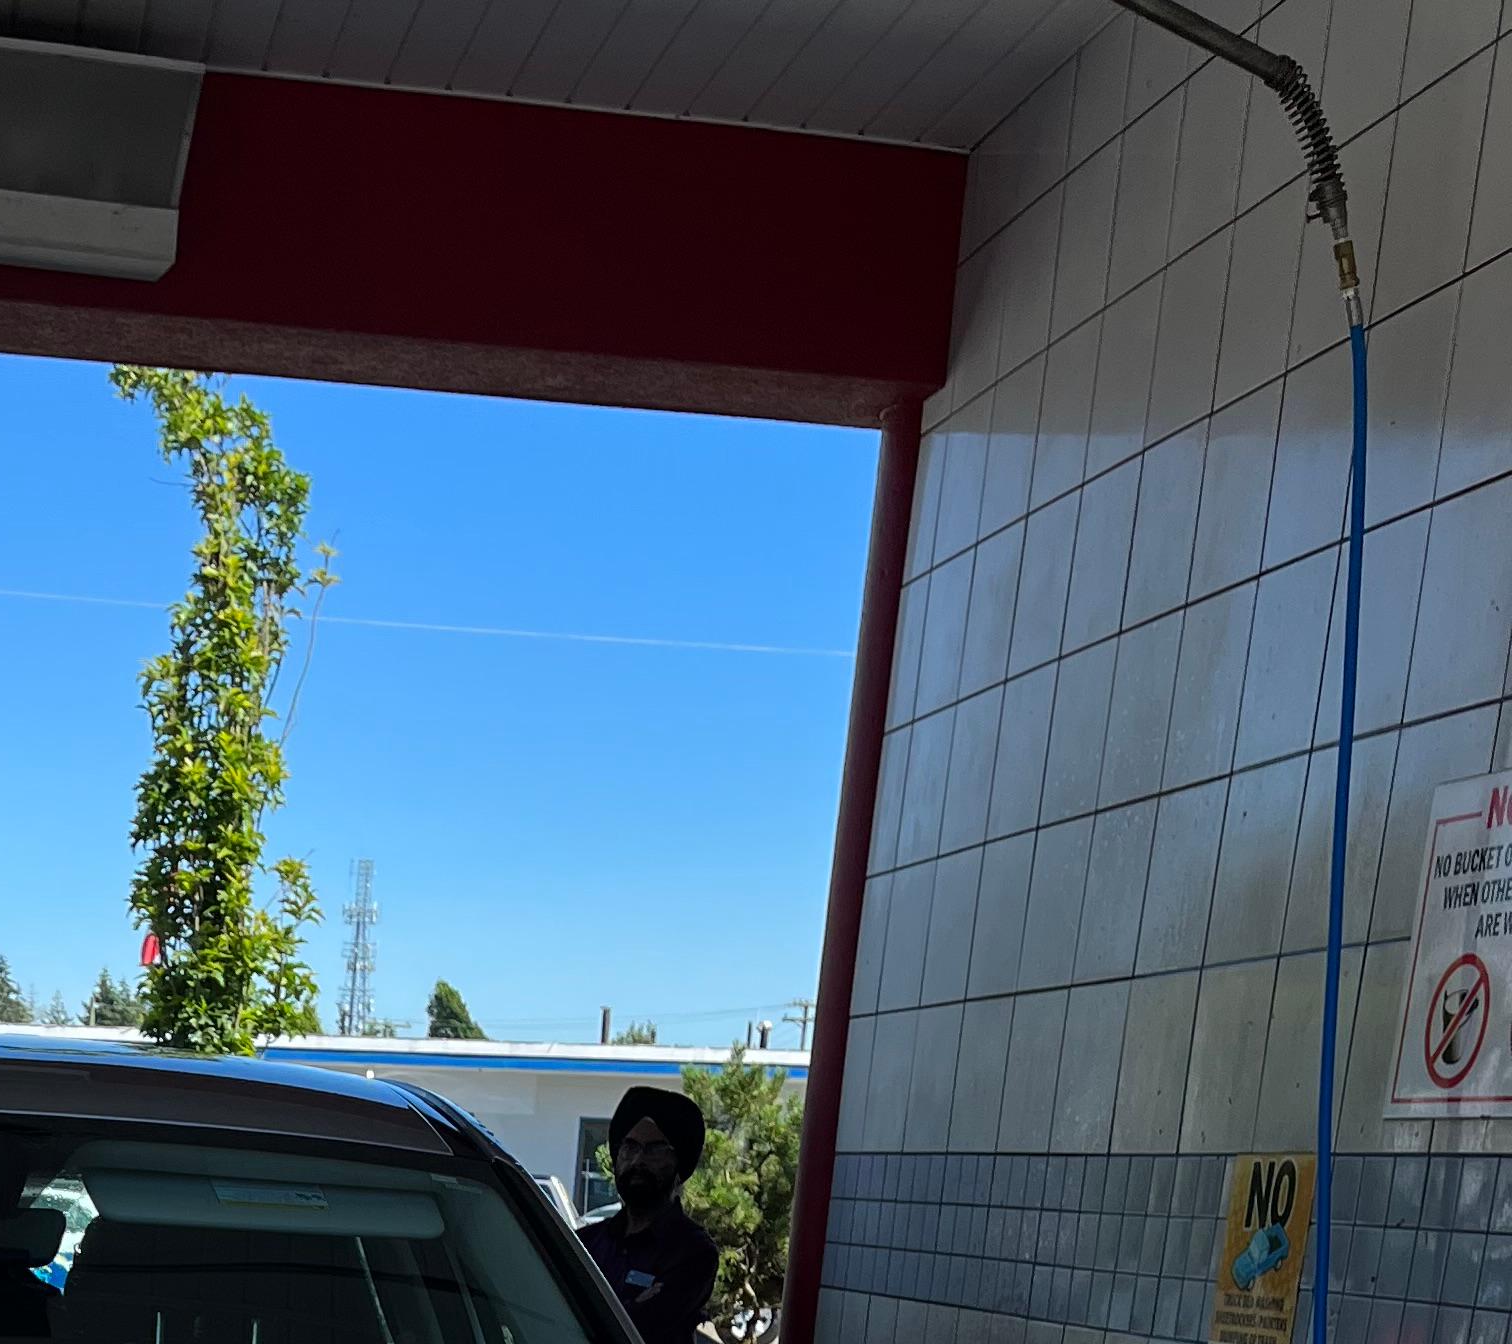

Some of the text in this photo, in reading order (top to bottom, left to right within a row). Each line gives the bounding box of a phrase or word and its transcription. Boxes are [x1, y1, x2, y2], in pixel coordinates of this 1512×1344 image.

[1434, 852, 1451, 879] NO
[1454, 845, 1503, 876] BUCKET
[1443, 882, 1479, 911] WHEN
[1475, 912, 1503, 939] ARE
[1244, 1159, 1297, 1230] NO
